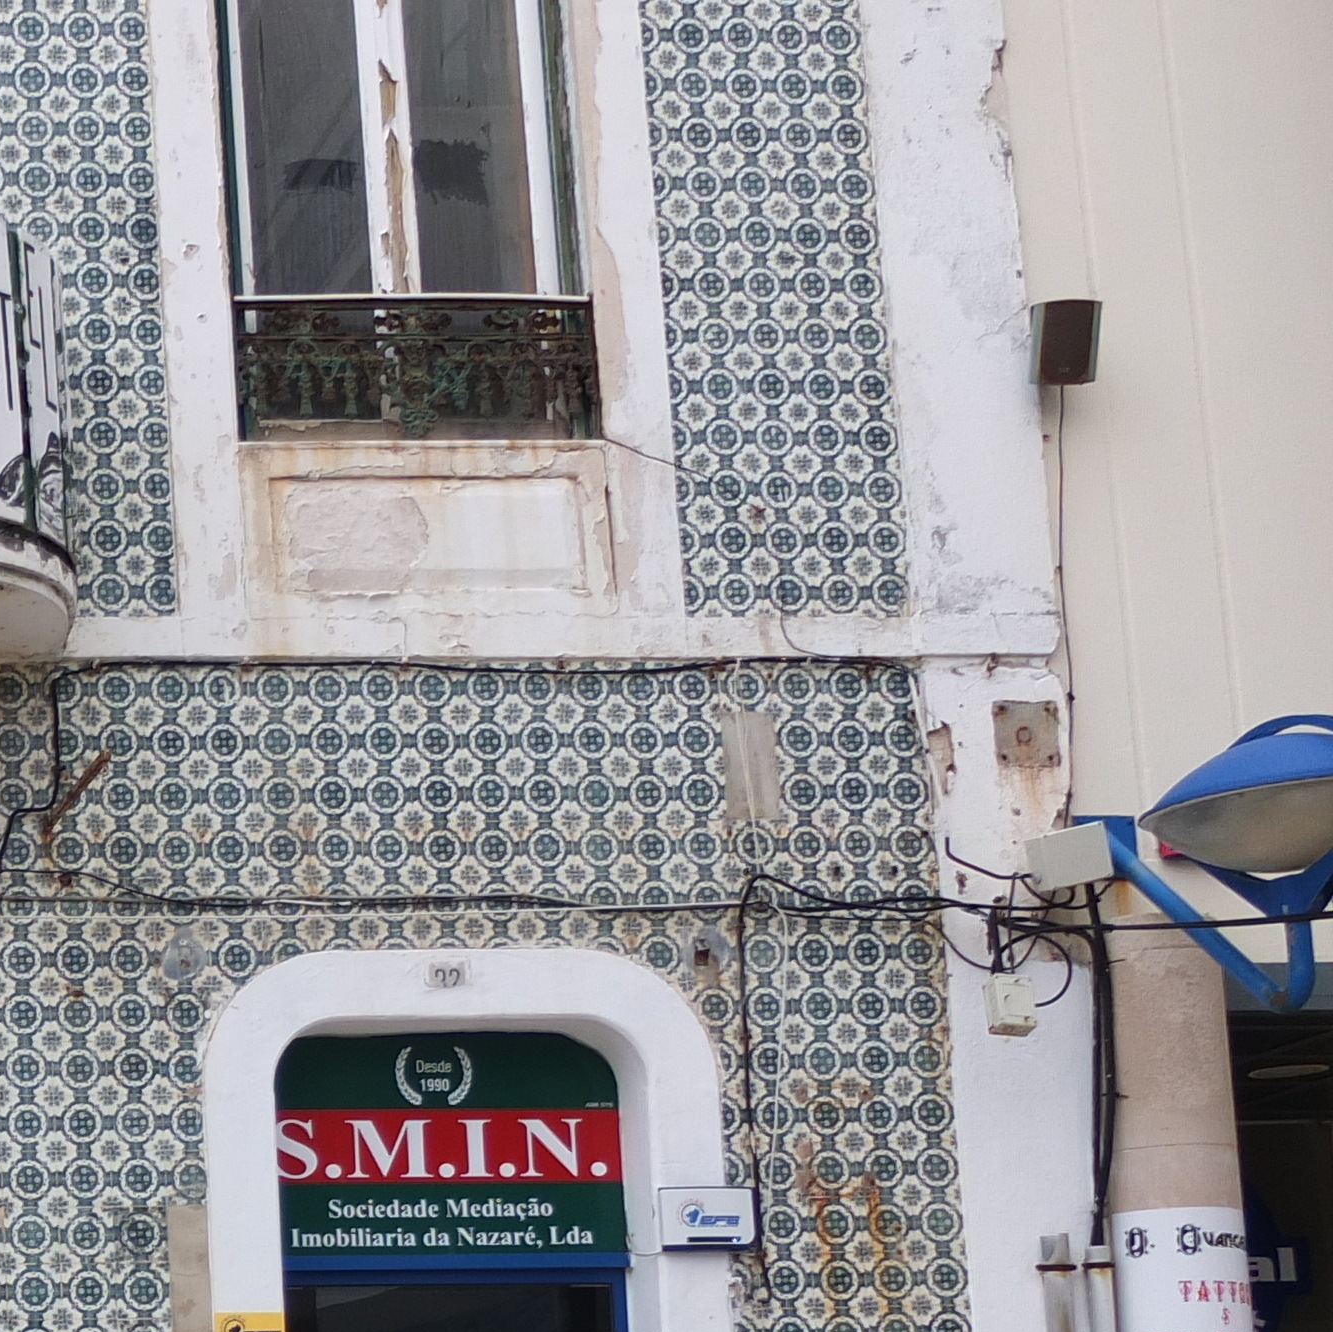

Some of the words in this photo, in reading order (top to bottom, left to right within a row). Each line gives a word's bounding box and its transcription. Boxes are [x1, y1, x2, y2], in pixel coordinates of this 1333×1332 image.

[415, 1060, 452, 1074] Desde
[419, 1078, 450, 1092] 1990
[276, 1118, 608, 1180] S.M.I.N.
[327, 1199, 439, 1219] Sociedade
[446, 1198, 553, 1222] Mediação
[422, 1228, 450, 1247] da
[457, 1226, 544, 1249] Nazaré,
[549, 1226, 593, 1245] Lda
